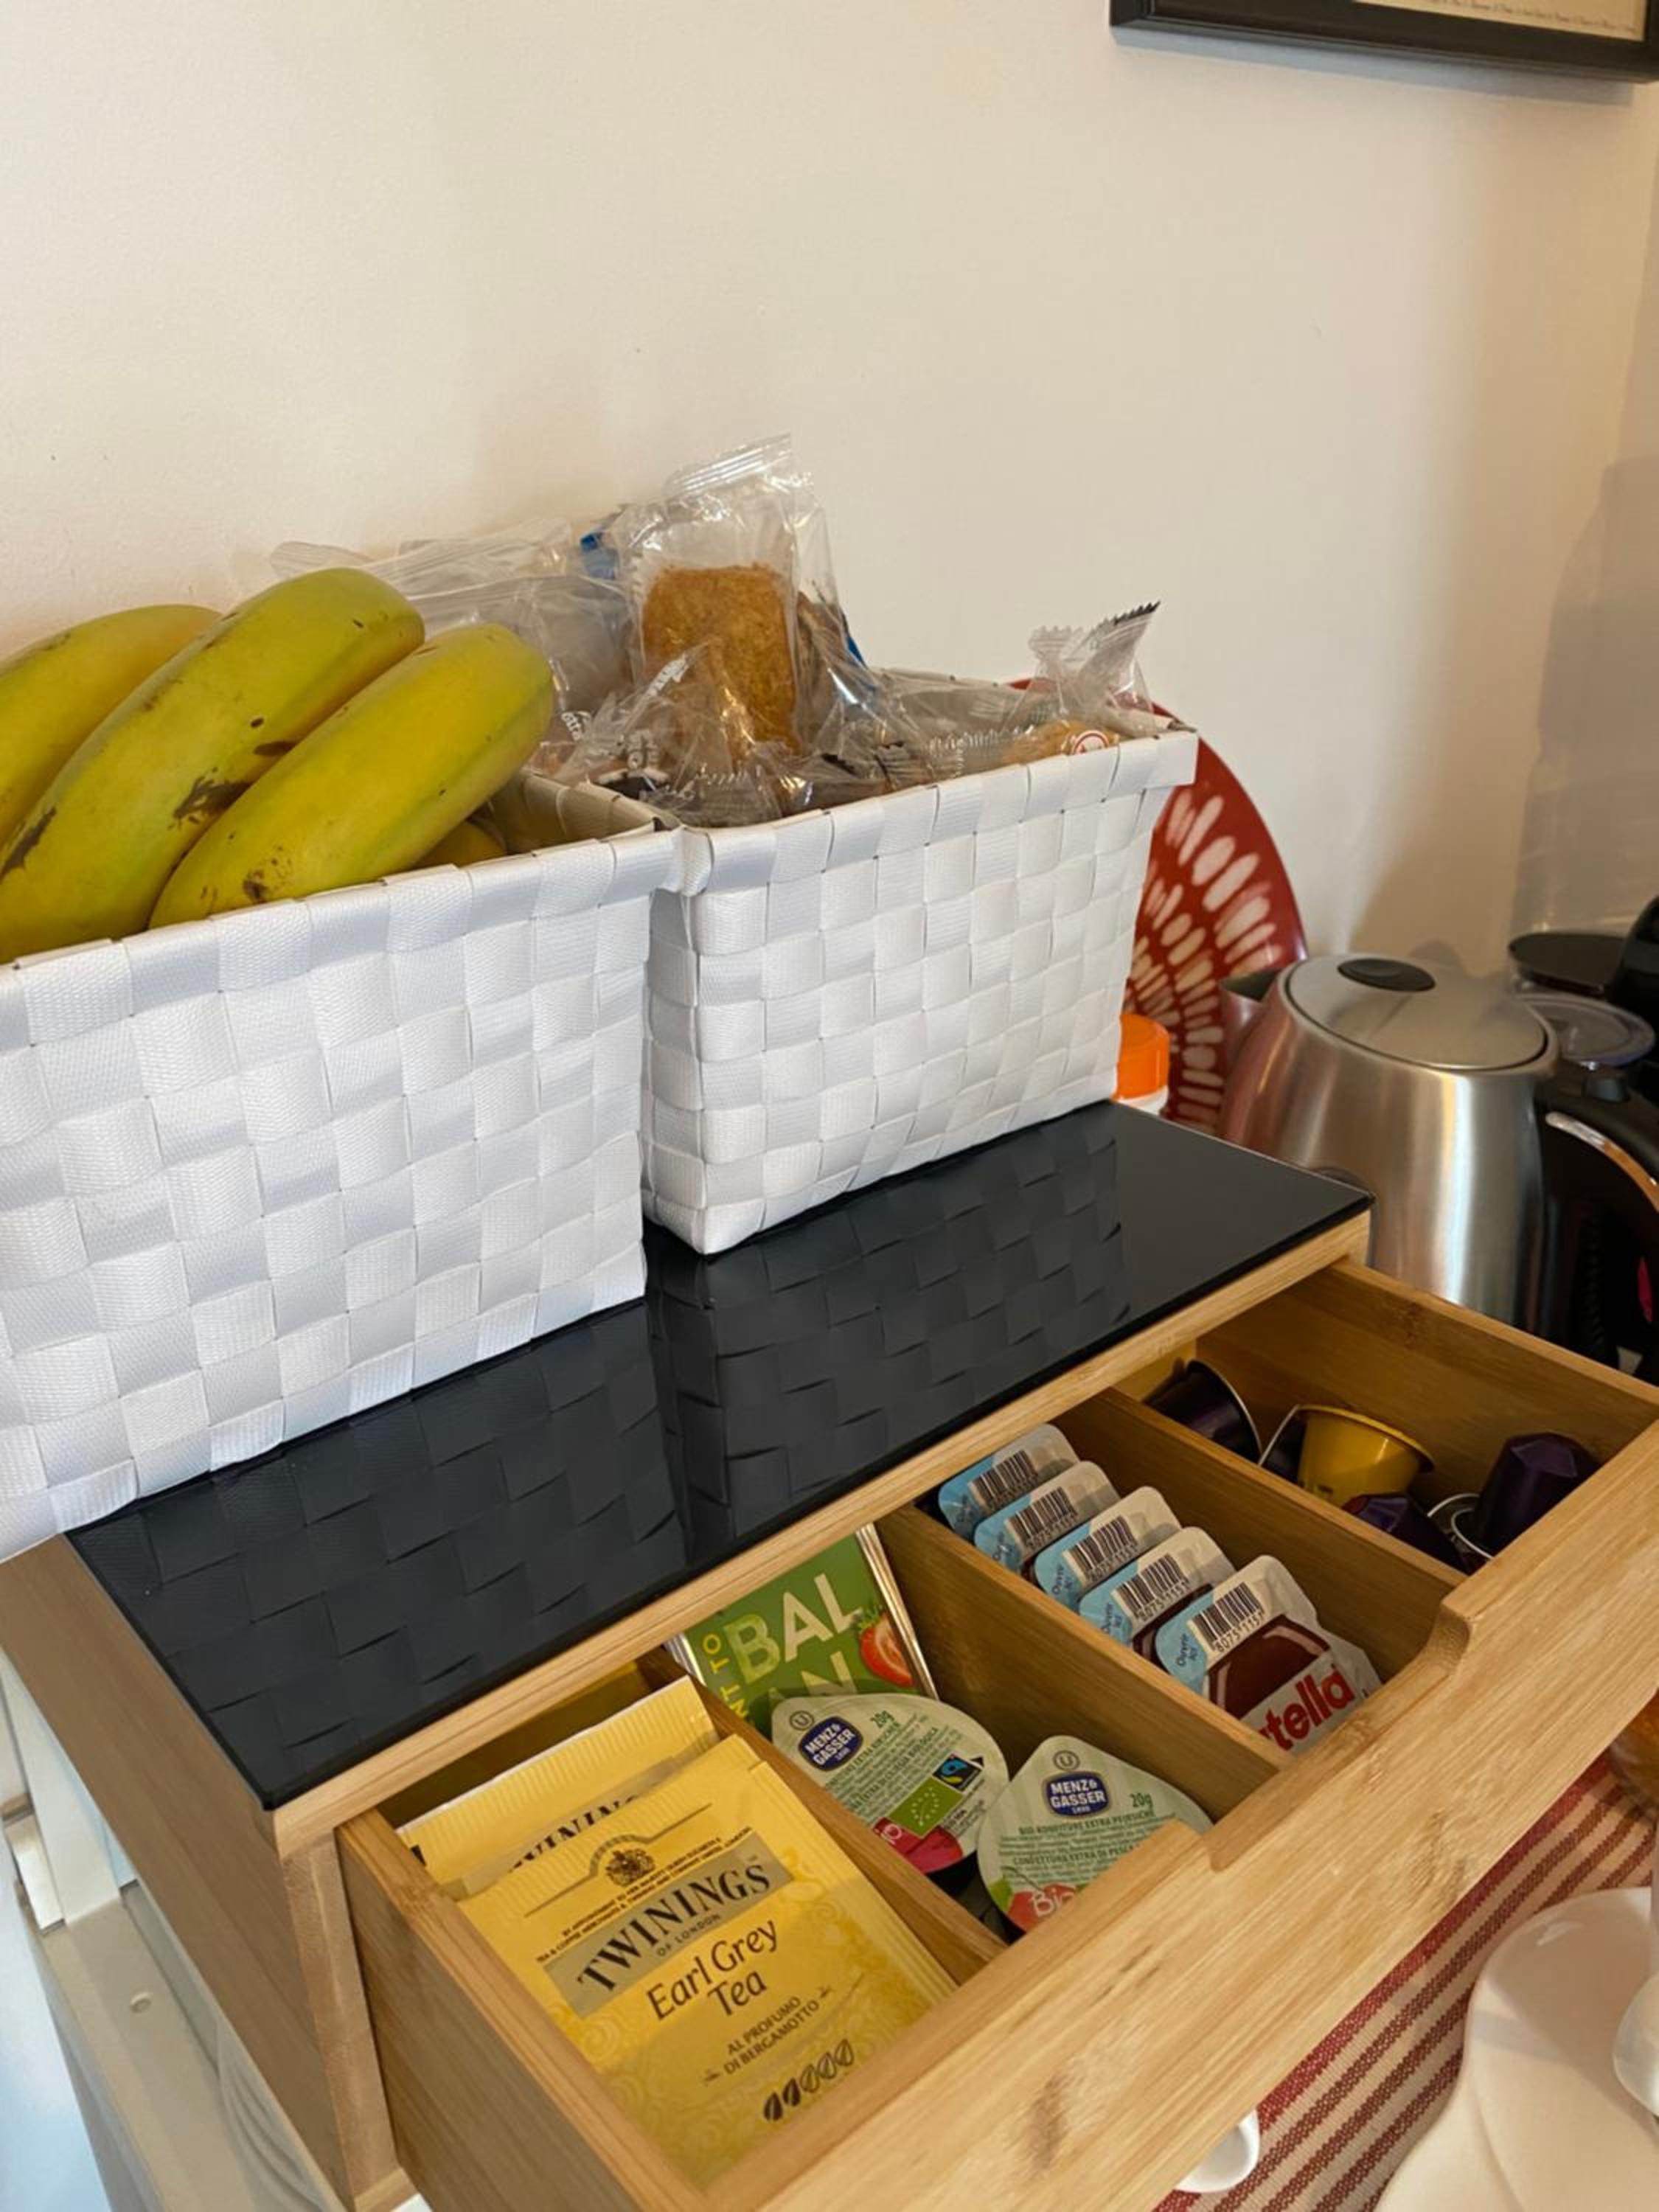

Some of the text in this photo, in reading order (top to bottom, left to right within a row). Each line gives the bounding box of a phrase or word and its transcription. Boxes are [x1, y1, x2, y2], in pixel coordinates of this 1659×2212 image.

[723, 1573, 863, 1684] BAL
[1217, 1631, 1241, 1652] 8075
[703, 1634, 749, 1718] NT TO
[1259, 1669, 1355, 1751] tella
[813, 1728, 856, 1765] GASSER
[1050, 1790, 1106, 1808] GASSER
[1130, 1792, 1155, 1810] 20g
[577, 1865, 771, 1991] TWININGS
[657, 1914, 721, 1958] OF LONDON
[647, 1920, 777, 2021] Earl Grey
[708, 1971, 767, 2017] Tea
[724, 2000, 820, 2076] DI BERGAMOTTO
[727, 1997, 801, 2056] AL PROFUMO
